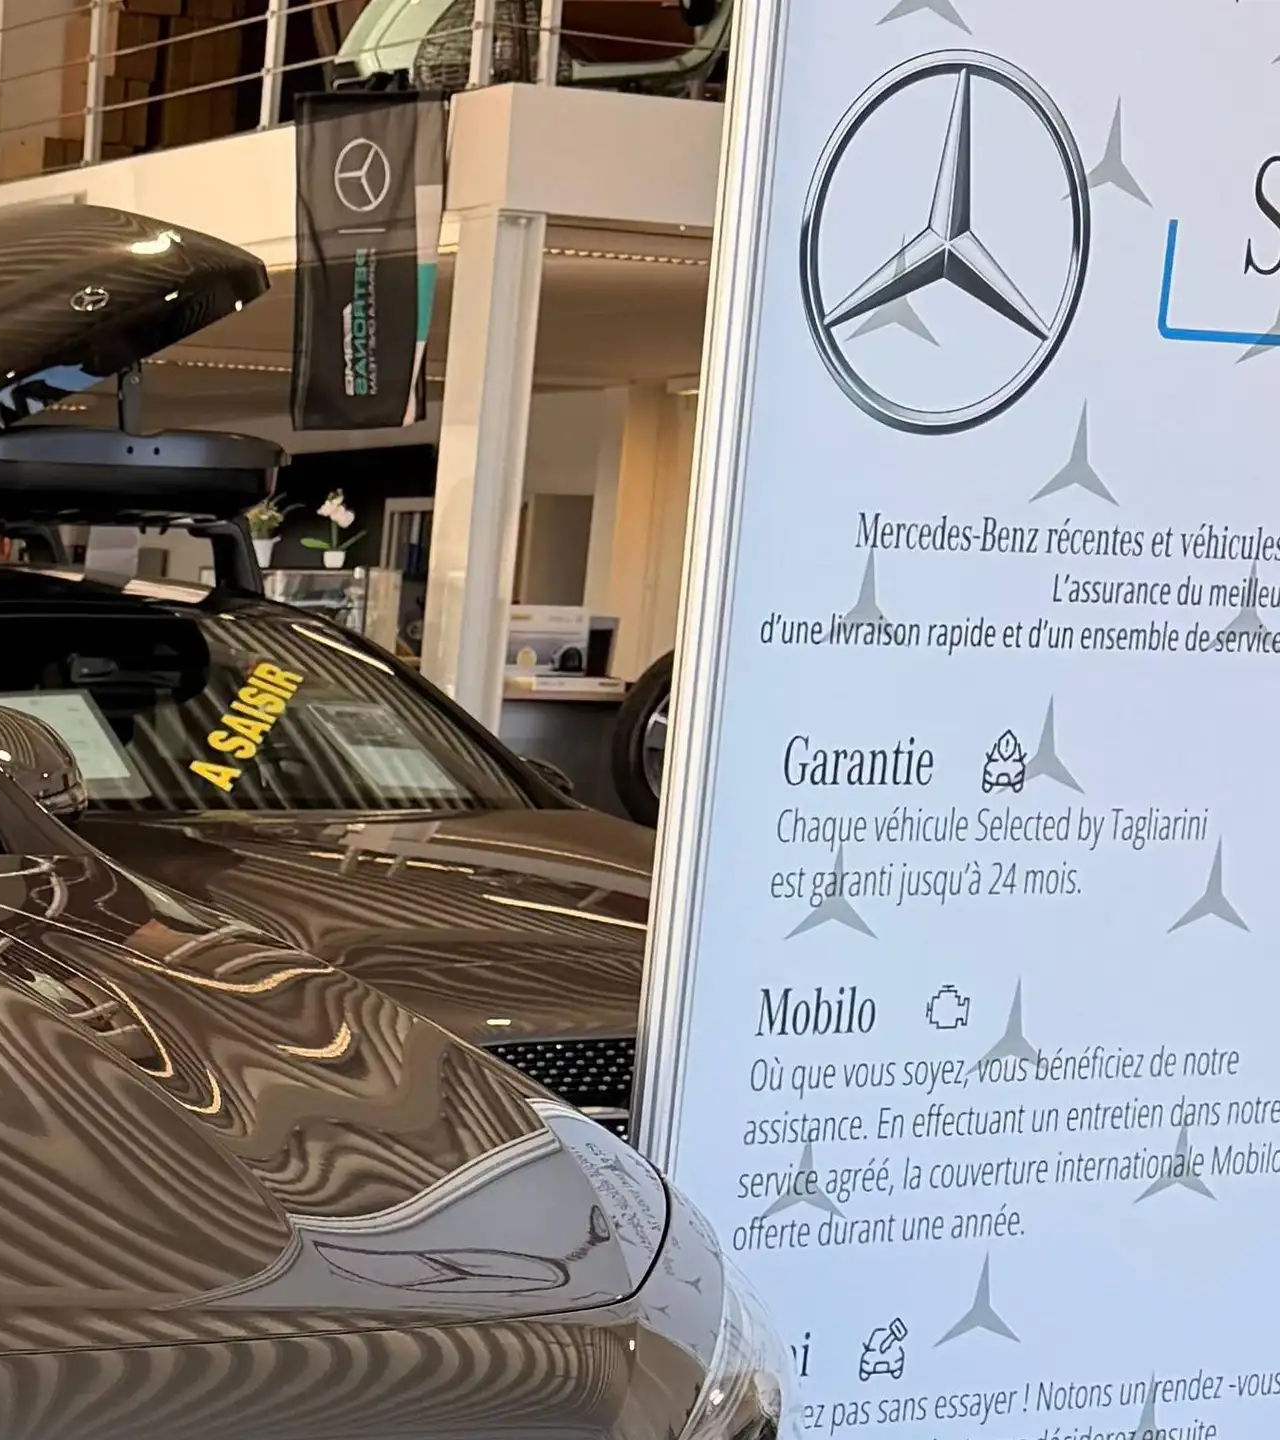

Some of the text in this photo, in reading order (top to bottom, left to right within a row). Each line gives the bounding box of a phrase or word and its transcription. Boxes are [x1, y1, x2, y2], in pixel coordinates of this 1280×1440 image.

[855, 512, 1039, 555] Mercedes-Benz
[1044, 518, 1144, 557] récentes
[1151, 527, 1173, 557] et
[1052, 574, 1171, 606] L'assurance
[1177, 575, 1203, 606] du
[760, 615, 824, 645] d'une
[829, 614, 920, 647] livraison
[926, 617, 996, 655] rapide
[1002, 622, 1023, 648] et
[1028, 619, 1073, 649] d'un
[1080, 620, 1179, 651] ensemble
[1185, 622, 1210, 652] de
[189, 661, 304, 793] A SAISIR
[783, 734, 934, 786] Garantie
[776, 806, 1208, 852] Chaque véhicule Selected by Tagliarini
[770, 862, 1082, 908] est garanti jusqu'à 24 mois.
[755, 986, 876, 1037] Mobilo
[750, 1045, 1239, 1099] Où que vous soyez, vous bénéficiez de notre
[743, 1095, 1280, 1146] assistance. En effectuant un entretien dans notre
[737, 1164, 818, 1200] service
[825, 1157, 894, 1203] agréé,
[903, 1157, 921, 1190] la
[930, 1155, 1048, 1189] couverture
[1055, 1145, 1204, 1183] internationale
[732, 1204, 1025, 1250] offerte durant une année.
[829, 1400, 870, 1436] pas
[876, 1396, 927, 1424] sans
[934, 1386, 1018, 1425] essayer
[1036, 1380, 1113, 1413] Notons
[1120, 1382, 1145, 1405] un
[1152, 1369, 1223, 1404] rendez
